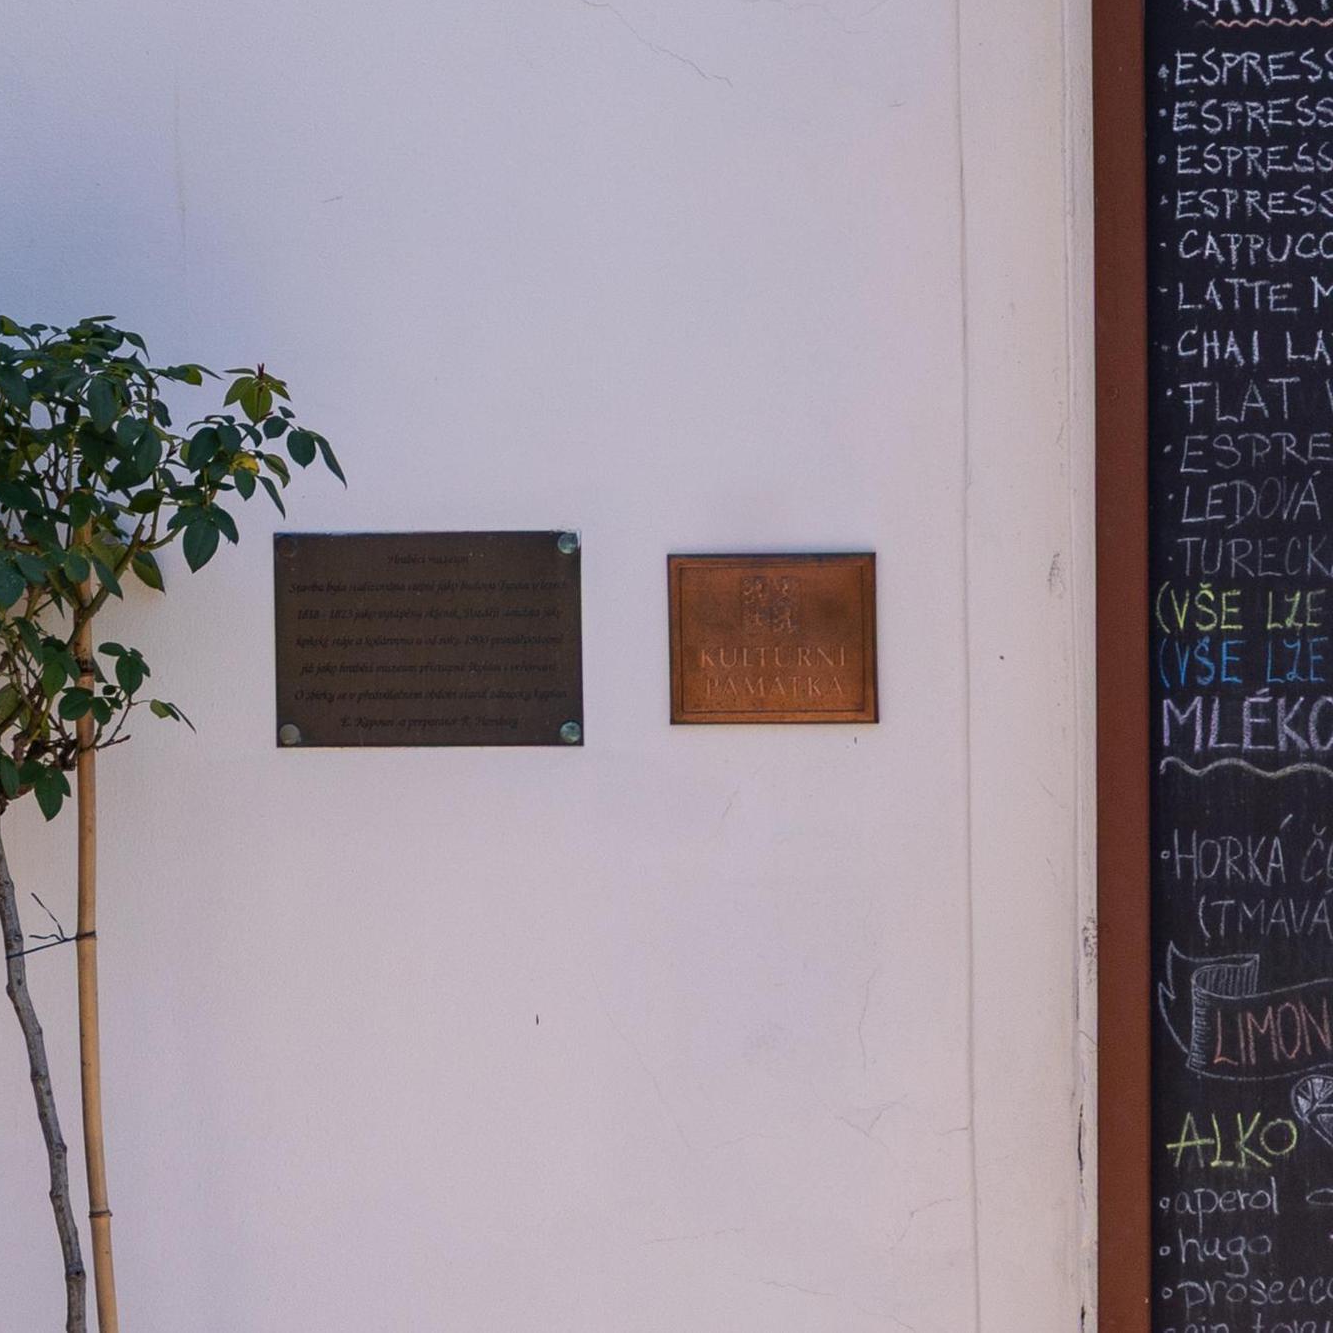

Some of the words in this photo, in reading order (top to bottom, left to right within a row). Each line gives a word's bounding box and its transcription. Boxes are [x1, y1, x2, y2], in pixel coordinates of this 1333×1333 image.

[1178, 277, 1300, 312] LATTE
[1177, 324, 1260, 368] CHAI
[1285, 329, 1333, 366] LA
[1179, 376, 1301, 424] FLAT
[1181, 470, 1321, 530] LEDOVÁ
[1176, 534, 1333, 579] TURECK
[1173, 814, 1293, 887] HORKÁ
[1166, 1112, 1298, 1168] ALKO
[1174, 1176, 1280, 1233] aperol
[1177, 1228, 1272, 1278] hugo
